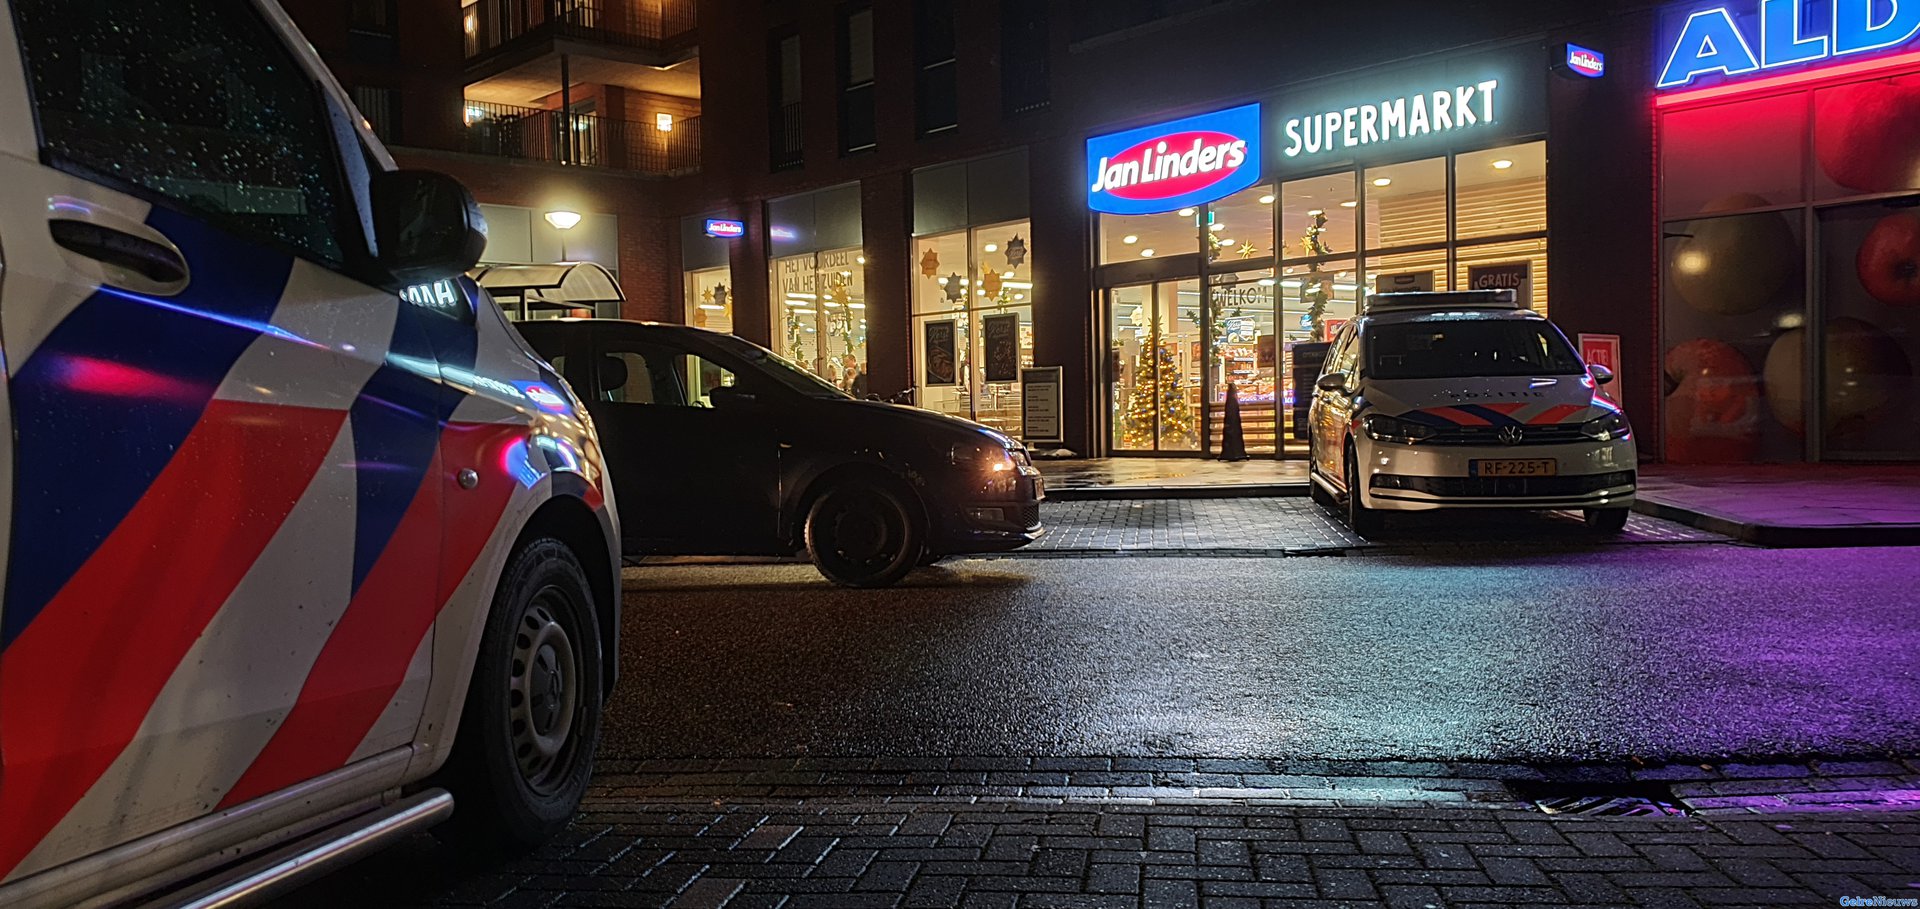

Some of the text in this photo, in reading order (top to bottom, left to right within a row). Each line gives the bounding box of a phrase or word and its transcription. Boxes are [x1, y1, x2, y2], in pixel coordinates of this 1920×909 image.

[1285, 79, 1498, 157] SUPERMARKT
[1091, 138, 1246, 193] Jan Linders
[785, 250, 849, 274] HET VOORDEEL
[783, 275, 800, 294] VAN
[821, 270, 853, 289] ZUIDEN
[1479, 272, 1520, 288] GRATIS
[1216, 286, 1267, 307] WELKOM
[1484, 461, 1550, 475] RF-225-T
